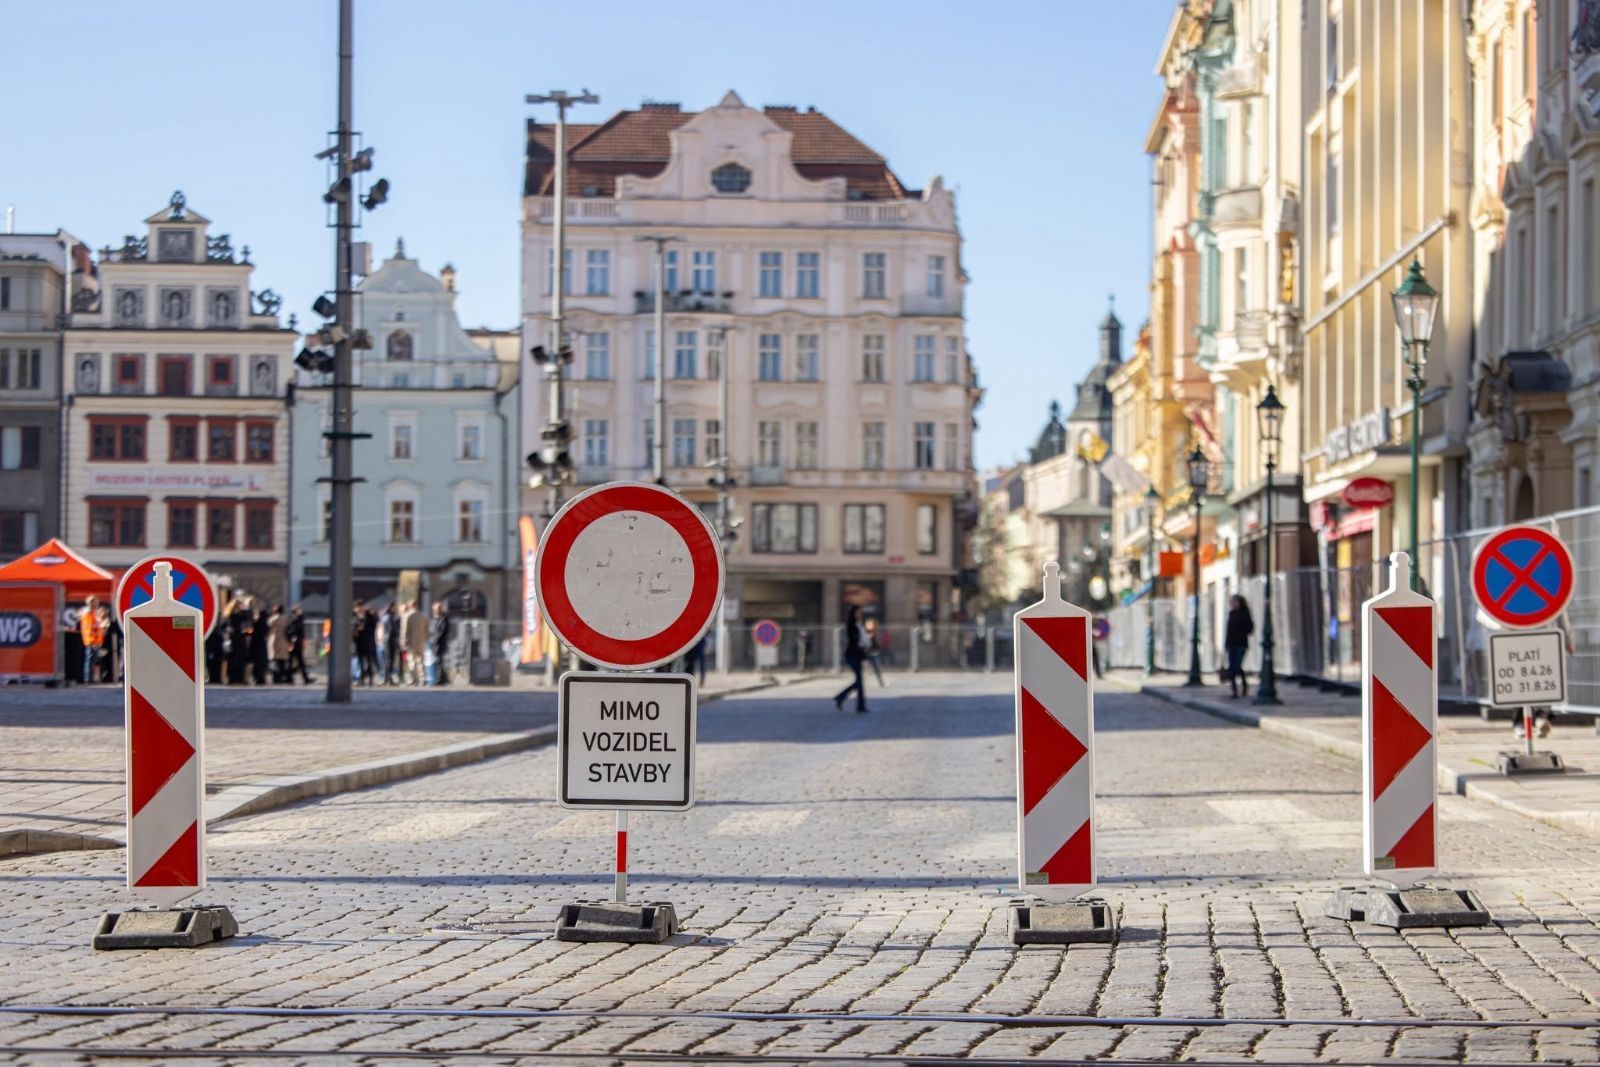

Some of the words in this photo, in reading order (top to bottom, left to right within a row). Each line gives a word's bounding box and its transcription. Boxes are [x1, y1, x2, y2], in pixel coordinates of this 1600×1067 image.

[1508, 647, 1540, 662] PLATÍ
[1498, 667, 1515, 678] OD
[1520, 665, 1552, 677] 8.4.26
[1496, 683, 1513, 694] DO
[600, 701, 660, 721] MIMO
[582, 732, 677, 752] VOZIDEL
[588, 763, 672, 783] STAVBY
